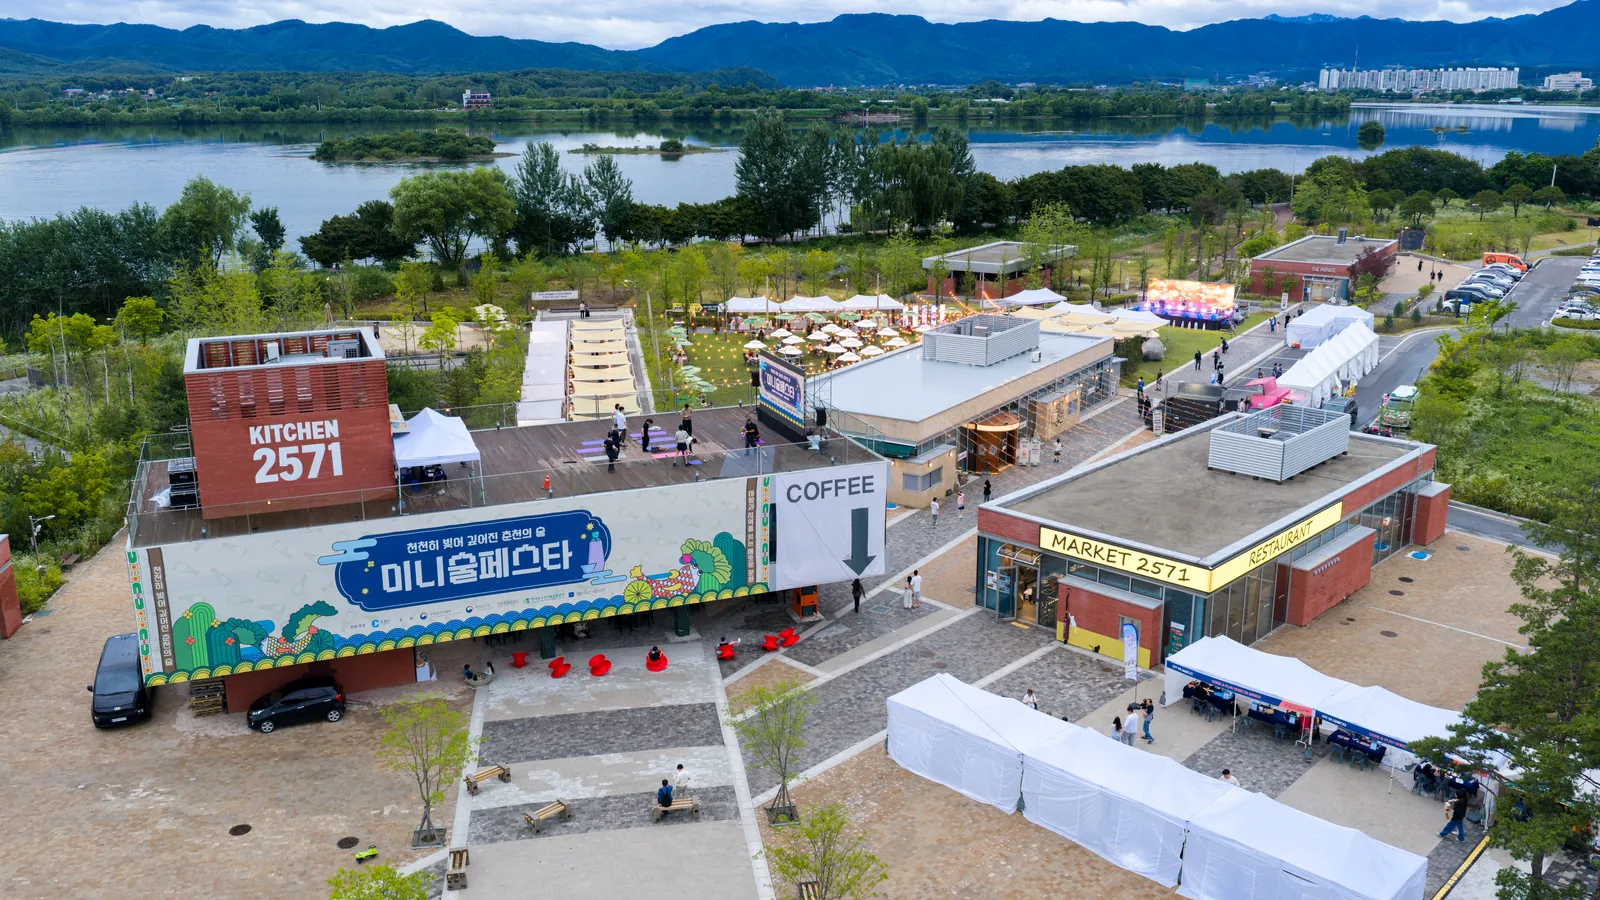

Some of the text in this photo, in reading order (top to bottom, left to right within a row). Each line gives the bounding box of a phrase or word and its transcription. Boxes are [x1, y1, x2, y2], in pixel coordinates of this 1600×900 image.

[249, 419, 339, 445] KITCHEN
[253, 442, 343, 484] 2571
[786, 475, 875, 504] COFFEE
[406, 526, 546, 554] 천천히 빚어 깊어진 춘천의 술
[1052, 534, 1191, 582] MARKET 2571
[1249, 519, 1314, 567] RESTAURANT
[381, 540, 573, 592] 미니술페스타
[153, 566, 163, 590] 천천히
[162, 634, 172, 657] 춘천의
